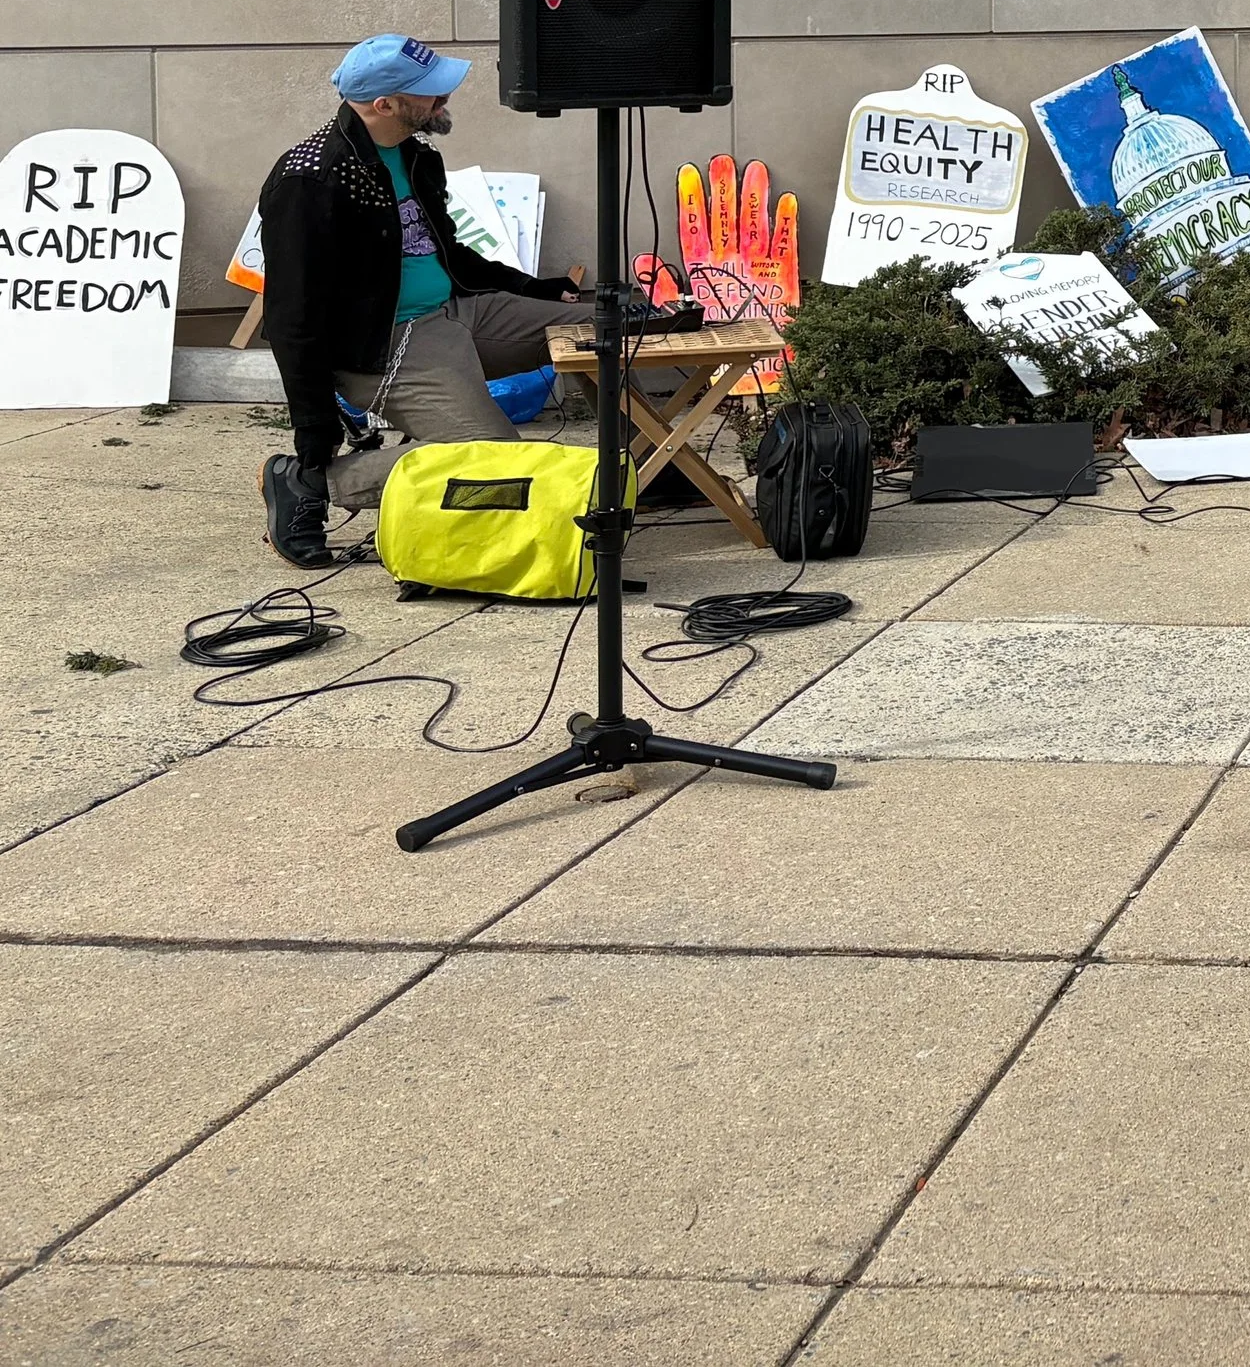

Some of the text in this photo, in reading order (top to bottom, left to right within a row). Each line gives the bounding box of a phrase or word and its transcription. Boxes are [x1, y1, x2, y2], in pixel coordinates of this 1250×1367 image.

[924, 73, 965, 93] RIP
[866, 114, 1013, 161] HEALTH
[861, 151, 983, 183] EQUITY
[25, 162, 152, 214] RIP
[888, 183, 980, 204] RESEARCH
[1124, 154, 1227, 224] PROTECT OUR
[719, 179, 729, 248] SOLEMNLY
[749, 193, 758, 240] SWEAR
[0, 225, 178, 263] ACADEMIC
[778, 217, 788, 256] THAT
[709, 262, 748, 279] WILL
[1049, 274, 1100, 293] MEMORY
[0, 279, 170, 312] REEDOM
[697, 283, 784, 300] DEFEND
